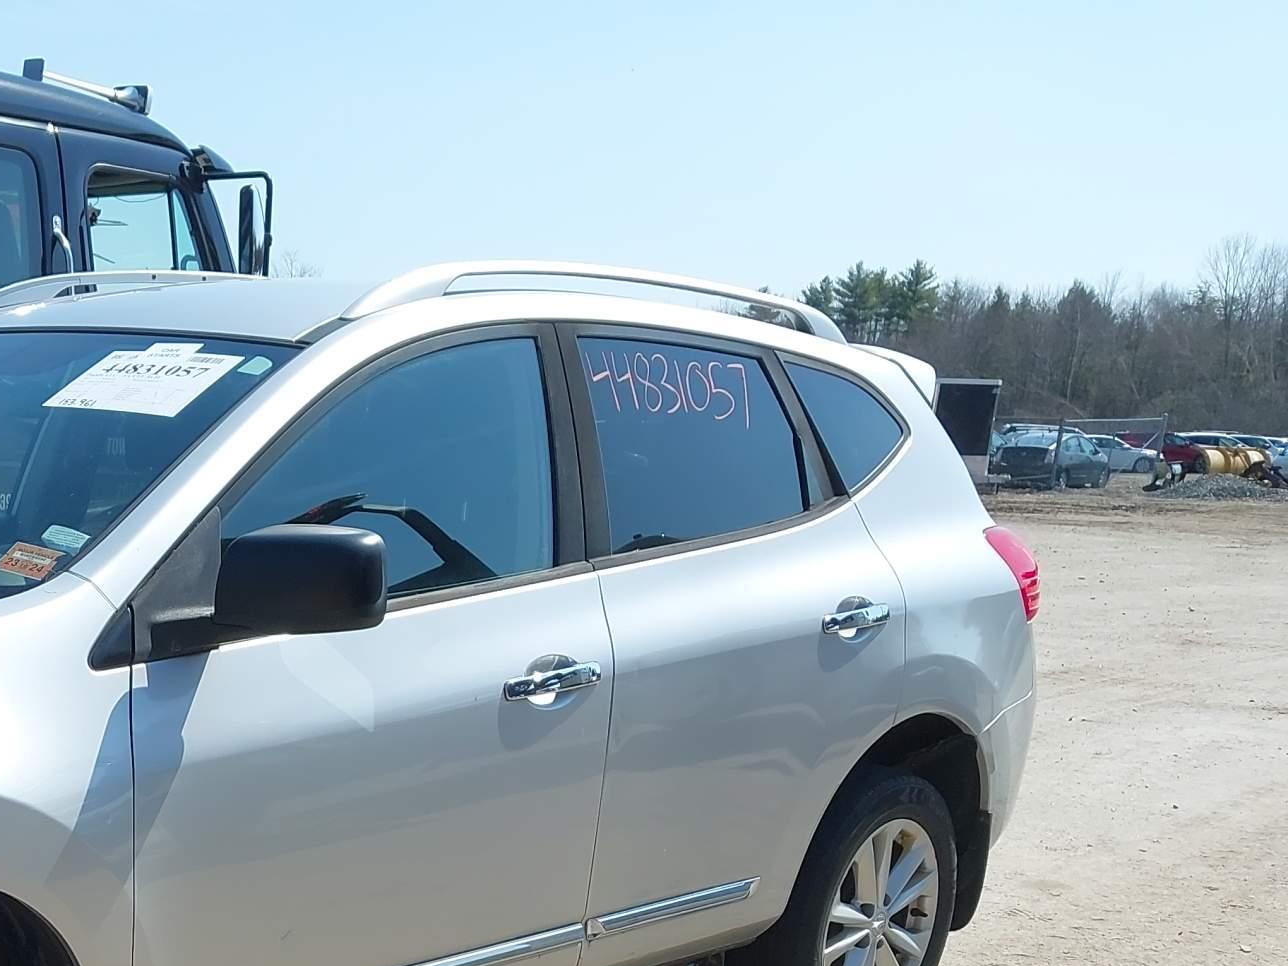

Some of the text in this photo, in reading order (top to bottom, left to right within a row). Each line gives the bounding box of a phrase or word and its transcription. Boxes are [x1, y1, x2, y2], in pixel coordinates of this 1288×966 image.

[101, 362, 211, 378] 44831057
[584, 351, 750, 430] 44831057
[28, 563, 45, 573] 24
